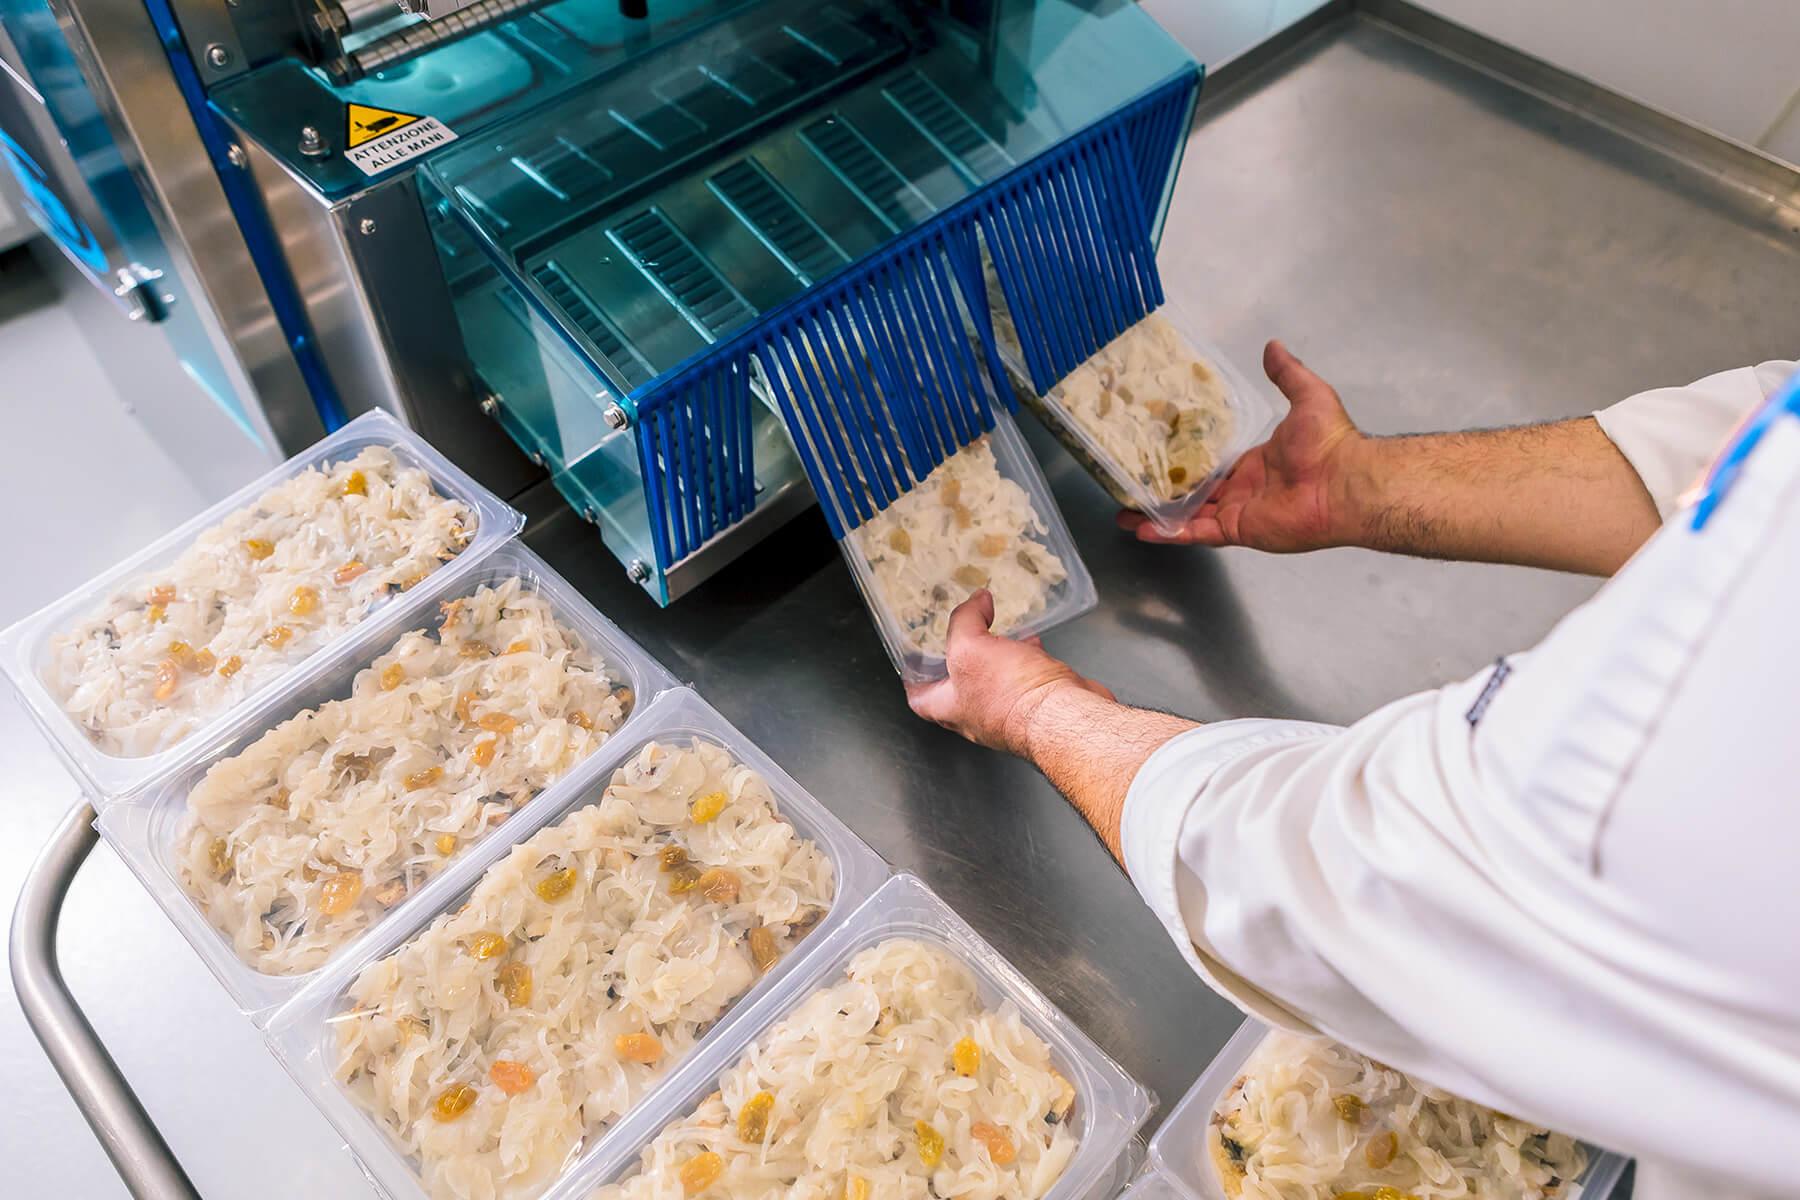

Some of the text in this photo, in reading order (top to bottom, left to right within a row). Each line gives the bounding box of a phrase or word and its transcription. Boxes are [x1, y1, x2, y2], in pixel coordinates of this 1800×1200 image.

[353, 120, 439, 161] ATTENZIONE
[371, 132, 444, 168] ALLE MANI
